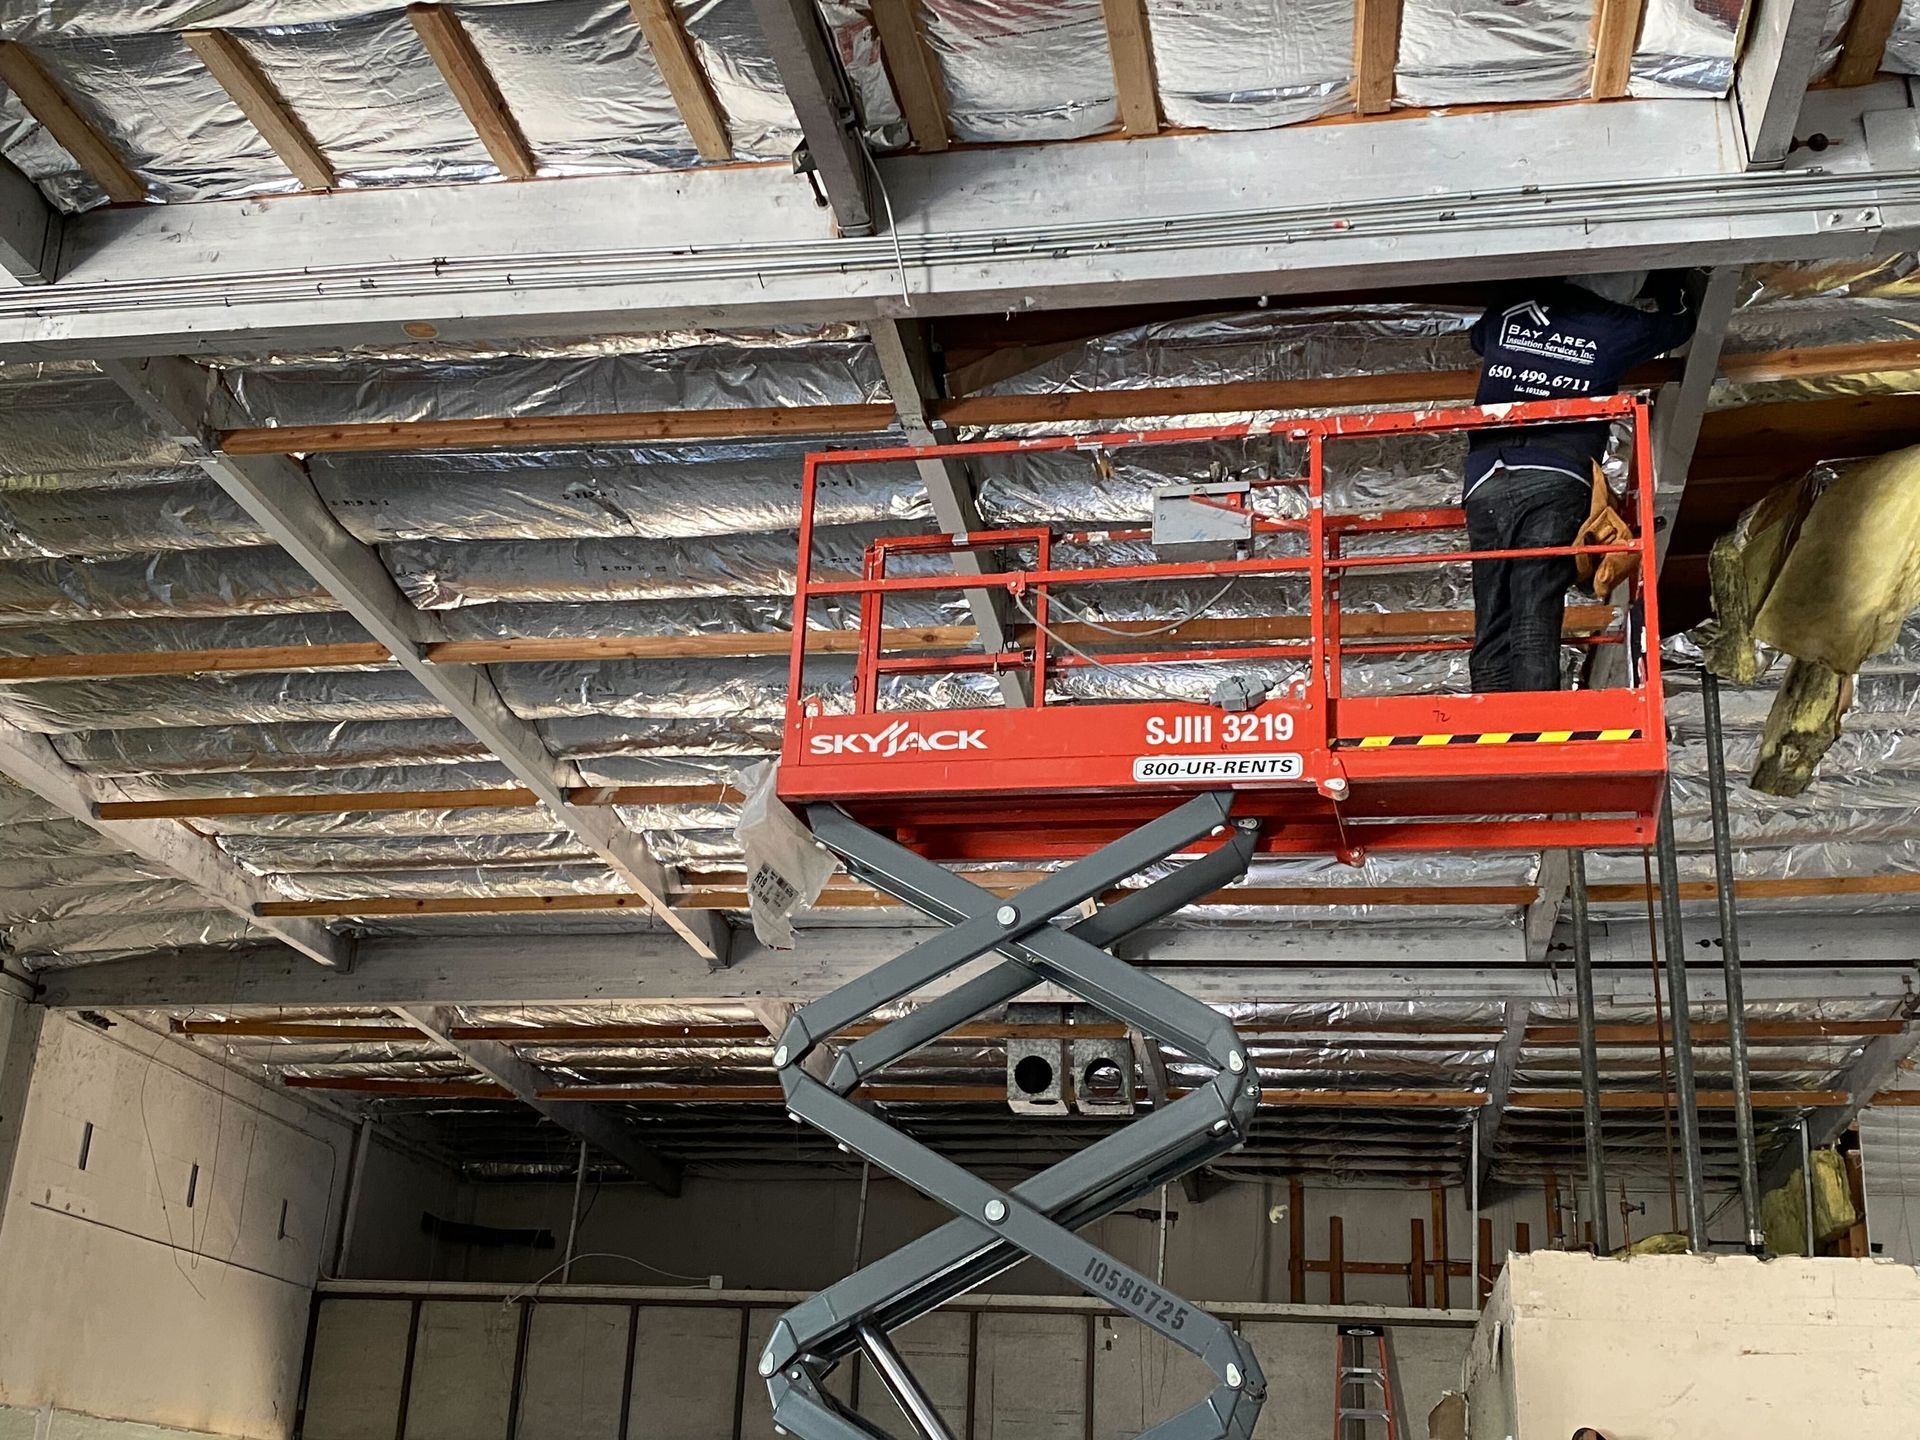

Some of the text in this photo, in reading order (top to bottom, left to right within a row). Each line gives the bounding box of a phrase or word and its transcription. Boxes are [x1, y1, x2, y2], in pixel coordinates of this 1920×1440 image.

[1506, 335, 1543, 350] Insulation
[1544, 342, 1579, 357] Services,
[1580, 350, 1596, 360] Inc.
[1508, 324, 1598, 351] BAY AREA
[1488, 364, 1591, 392] 650.499.6711
[810, 719, 989, 758] SKYJACK
[1145, 712, 1294, 745] SJIII 3219
[1142, 759, 1294, 776] 800-UR-RENTS
[754, 871, 768, 888] R19
[1084, 1257, 1189, 1330] 10586725
